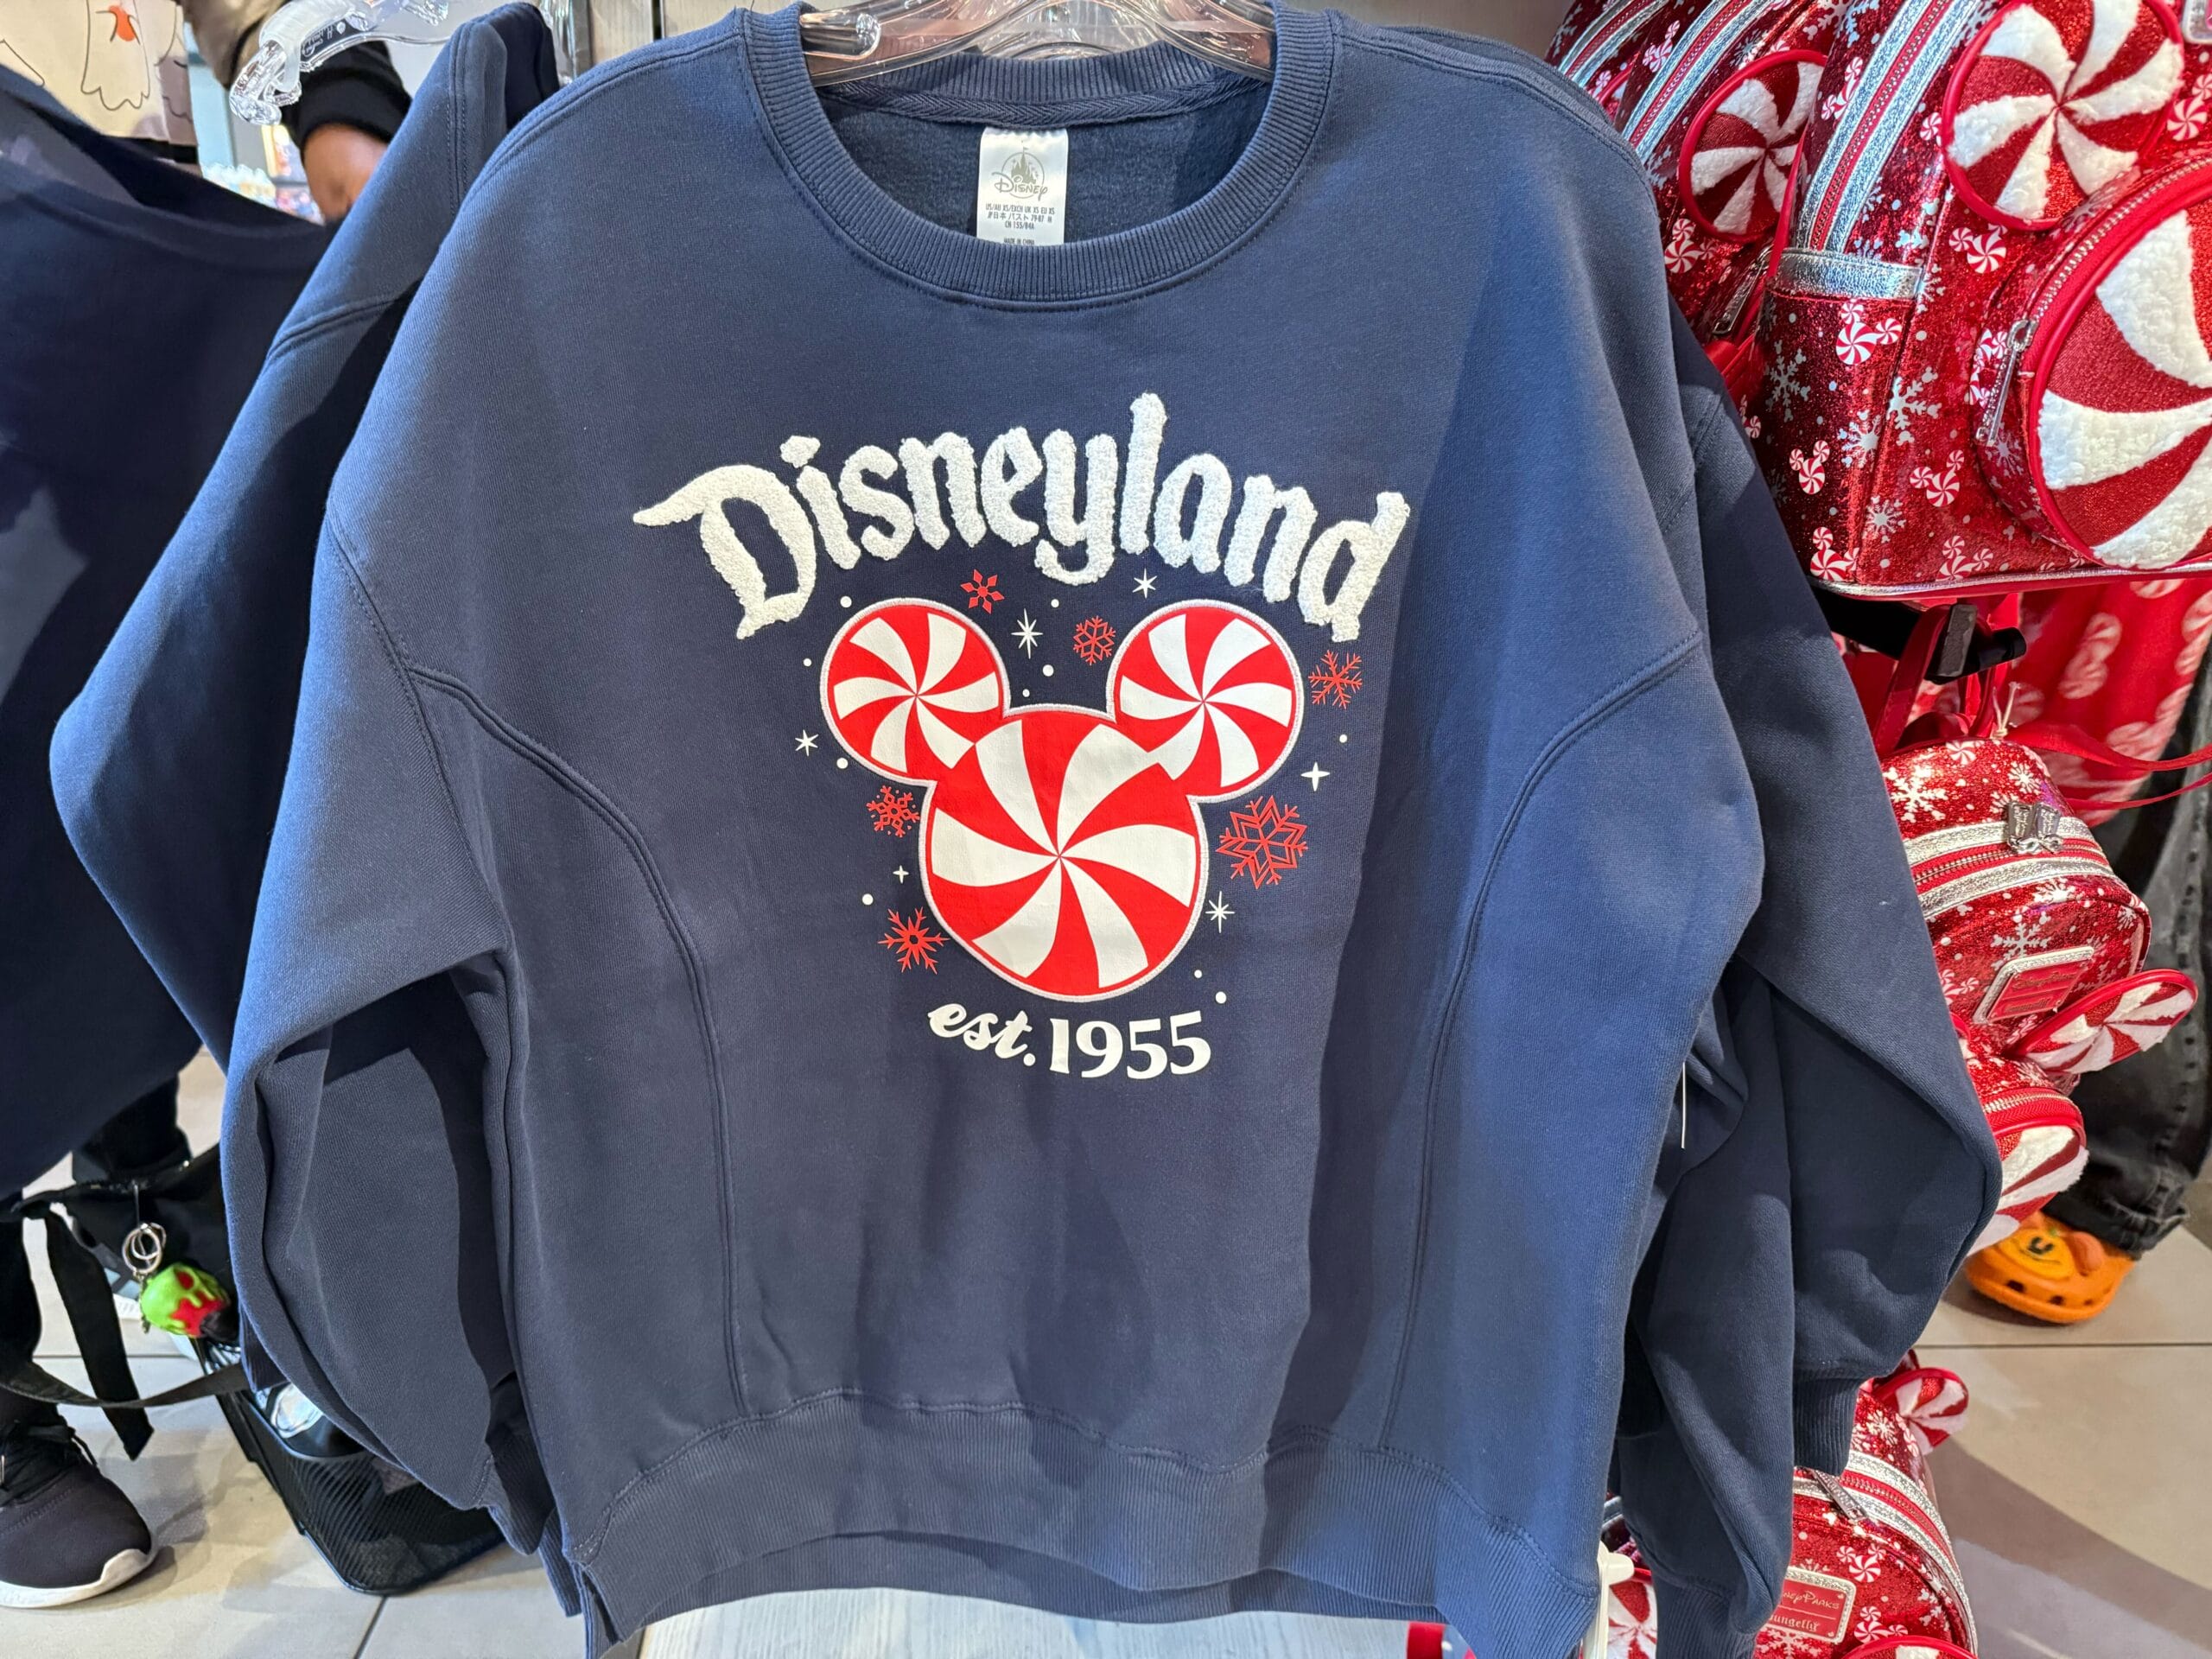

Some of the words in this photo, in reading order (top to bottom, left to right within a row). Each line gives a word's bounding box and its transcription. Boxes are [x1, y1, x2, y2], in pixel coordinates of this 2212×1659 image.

[991, 171, 1048, 201] Disney
[633, 392, 1410, 641] Disneyland
[927, 1003, 1036, 1066] est.
[1049, 1010, 1211, 1079] 1955
